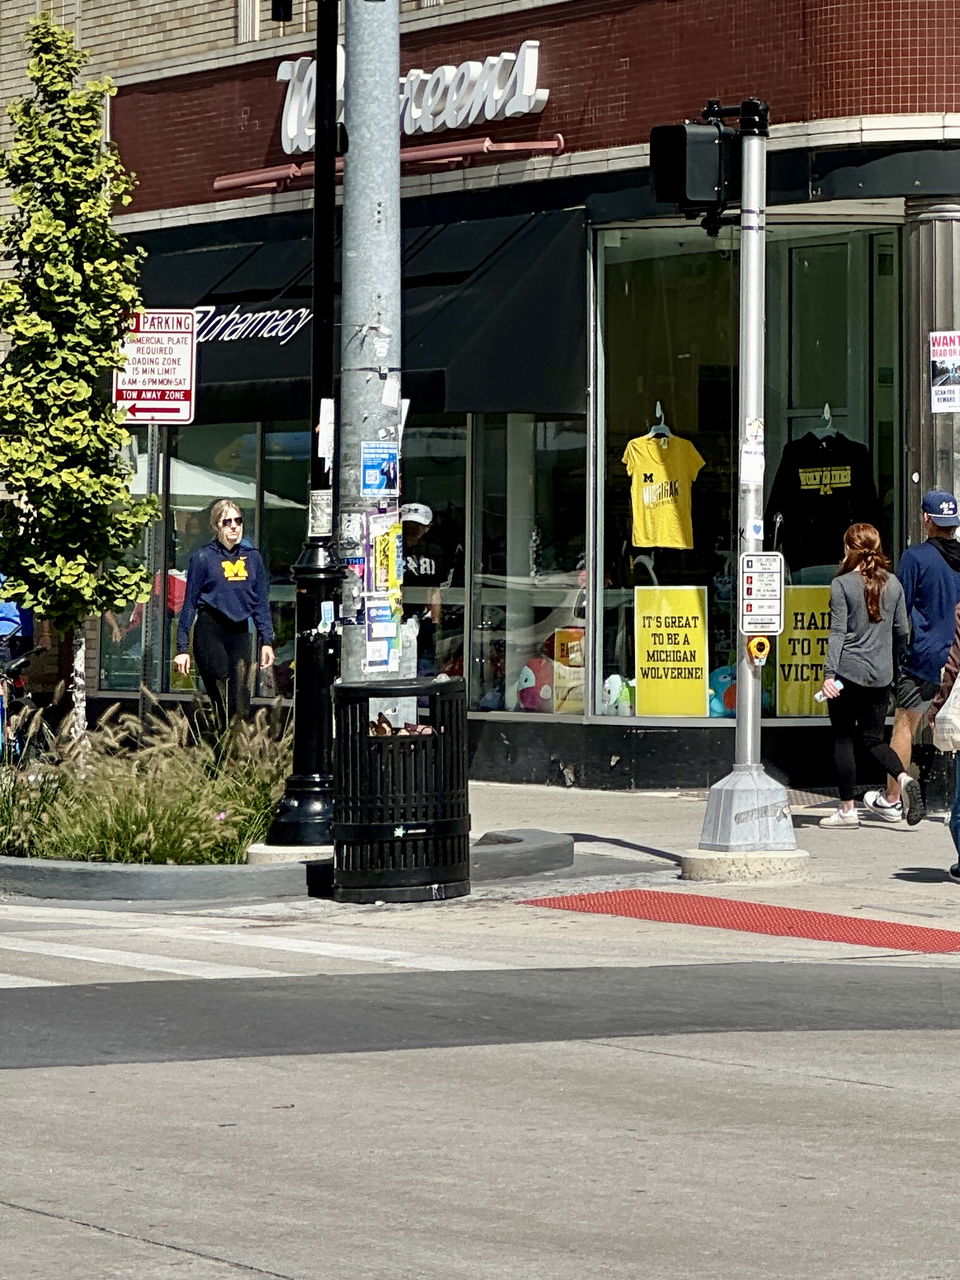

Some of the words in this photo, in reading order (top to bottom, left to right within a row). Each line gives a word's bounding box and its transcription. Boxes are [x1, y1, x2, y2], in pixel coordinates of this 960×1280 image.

[277, 40, 549, 155] Wreens
[142, 316, 190, 330] PARKING
[126, 336, 165, 345] OMERCIAL
[167, 336, 189, 345] PLATE
[136, 346, 174, 355] REQUIRED
[932, 348, 948, 358] DEAD
[948, 348, 958, 357] OR
[127, 357, 160, 366] LOADING
[162, 357, 182, 366] ZONE
[132, 367, 140, 376] 15
[142, 367, 156, 376] MIN
[157, 367, 177, 376] LIMIT
[121, 378, 127, 386] 6
[128, 378, 138, 386] AM
[142, 378, 147, 386] 6
[147, 378, 158, 386] PM
[158, 378, 187, 386] MON-SAT
[122, 390, 138, 400] TOW
[141, 390, 161, 400] AWAY
[164, 390, 185, 400] ZONE
[643, 473, 654, 483] M
[221, 560, 248, 577] M
[642, 616, 663, 628] IT'S
[665, 616, 699, 628] GREAT
[651, 633, 664, 645] TO
[667, 633, 680, 645] BE
[682, 633, 691, 645] A
[788, 638, 811, 656] TO
[646, 650, 696, 663] MICHIGAN
[640, 667, 703, 680] WOLVERINE!
[780, 663, 825, 681] VICT
